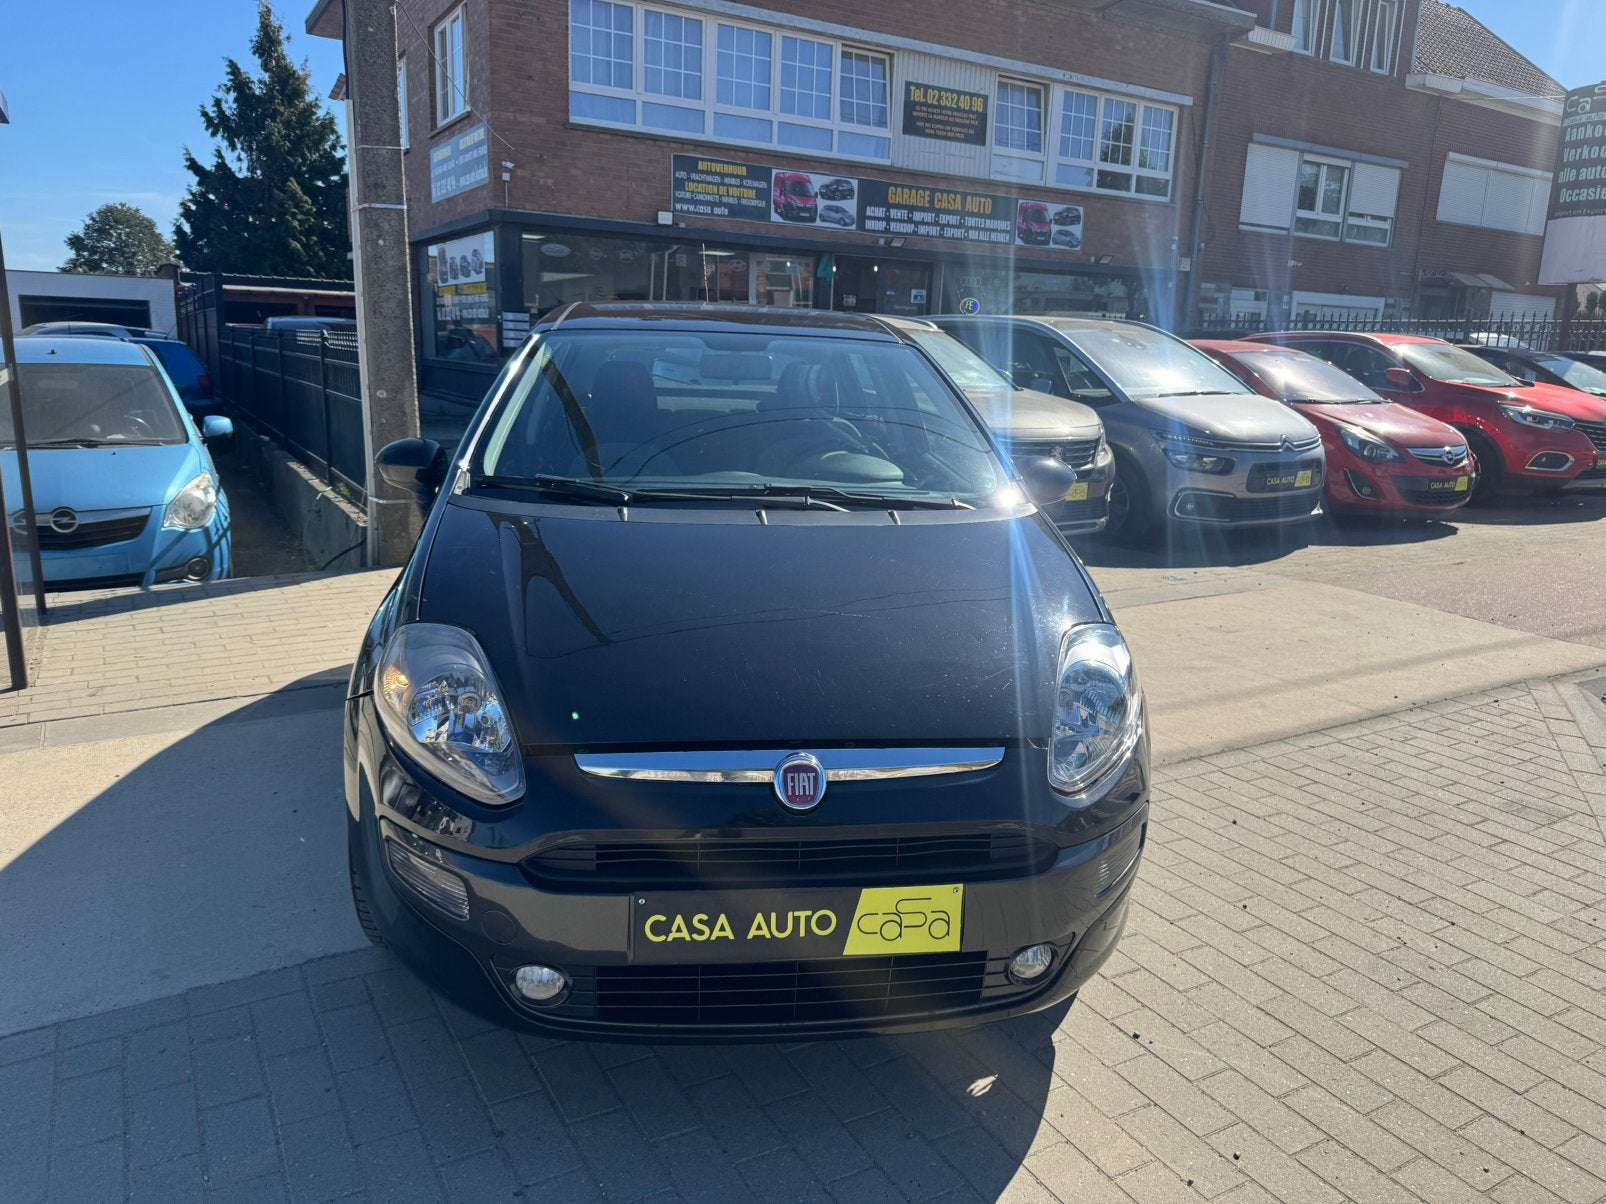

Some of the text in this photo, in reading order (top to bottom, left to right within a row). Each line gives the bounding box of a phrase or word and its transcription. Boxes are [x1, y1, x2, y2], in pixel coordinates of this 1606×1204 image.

[910, 86, 983, 112] Tel. 02 332 40 96
[1565, 124, 1606, 142] Aanko
[698, 160, 746, 176] AUTOVERHUUR
[1558, 168, 1576, 183] alle
[685, 181, 756, 198] LOCATION DE VOITURE
[888, 186, 992, 214] GARAGE CASA AUTO
[714, 206, 728, 215] auto
[866, 206, 1010, 230] ACHAT VENTE IMPORT EXPORT TOUTES MARQUES
[865, 219, 1009, 243] INKOOP VERKOOP IMPORT EXPORT VAN ALLE MERKEN
[1281, 476, 1294, 484] AUTO
[787, 772, 815, 796] FIAT
[644, 913, 735, 942] CASA
[746, 909, 837, 940] AUTO
